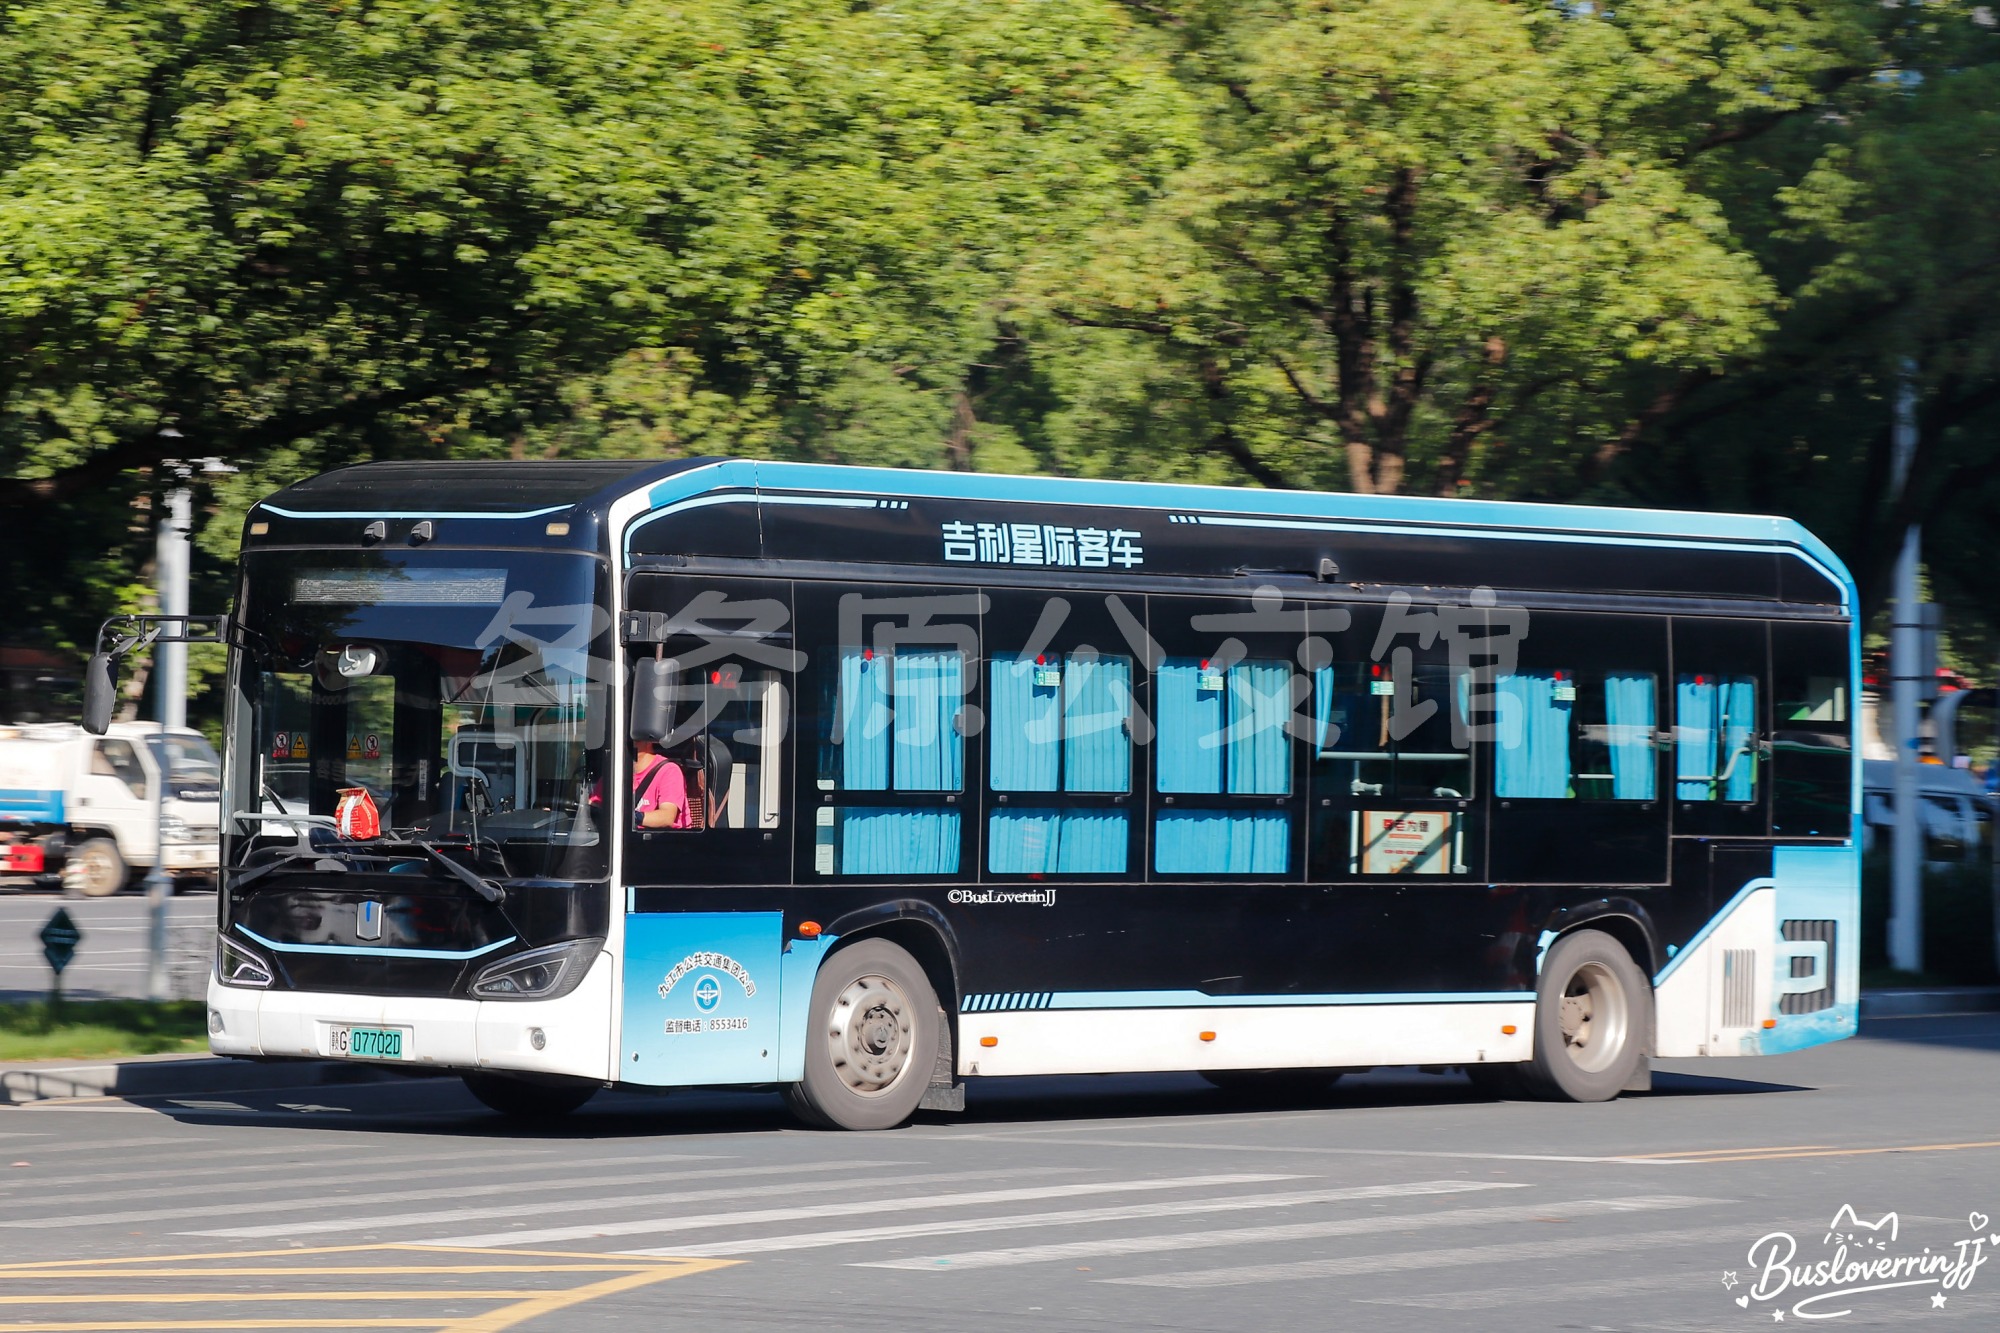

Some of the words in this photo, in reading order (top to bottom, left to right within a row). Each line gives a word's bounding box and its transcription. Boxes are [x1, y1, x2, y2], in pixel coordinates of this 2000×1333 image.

[941, 520, 1144, 568] 吉利星际客车
[658, 952, 757, 999] 九江市公共交通集团公司
